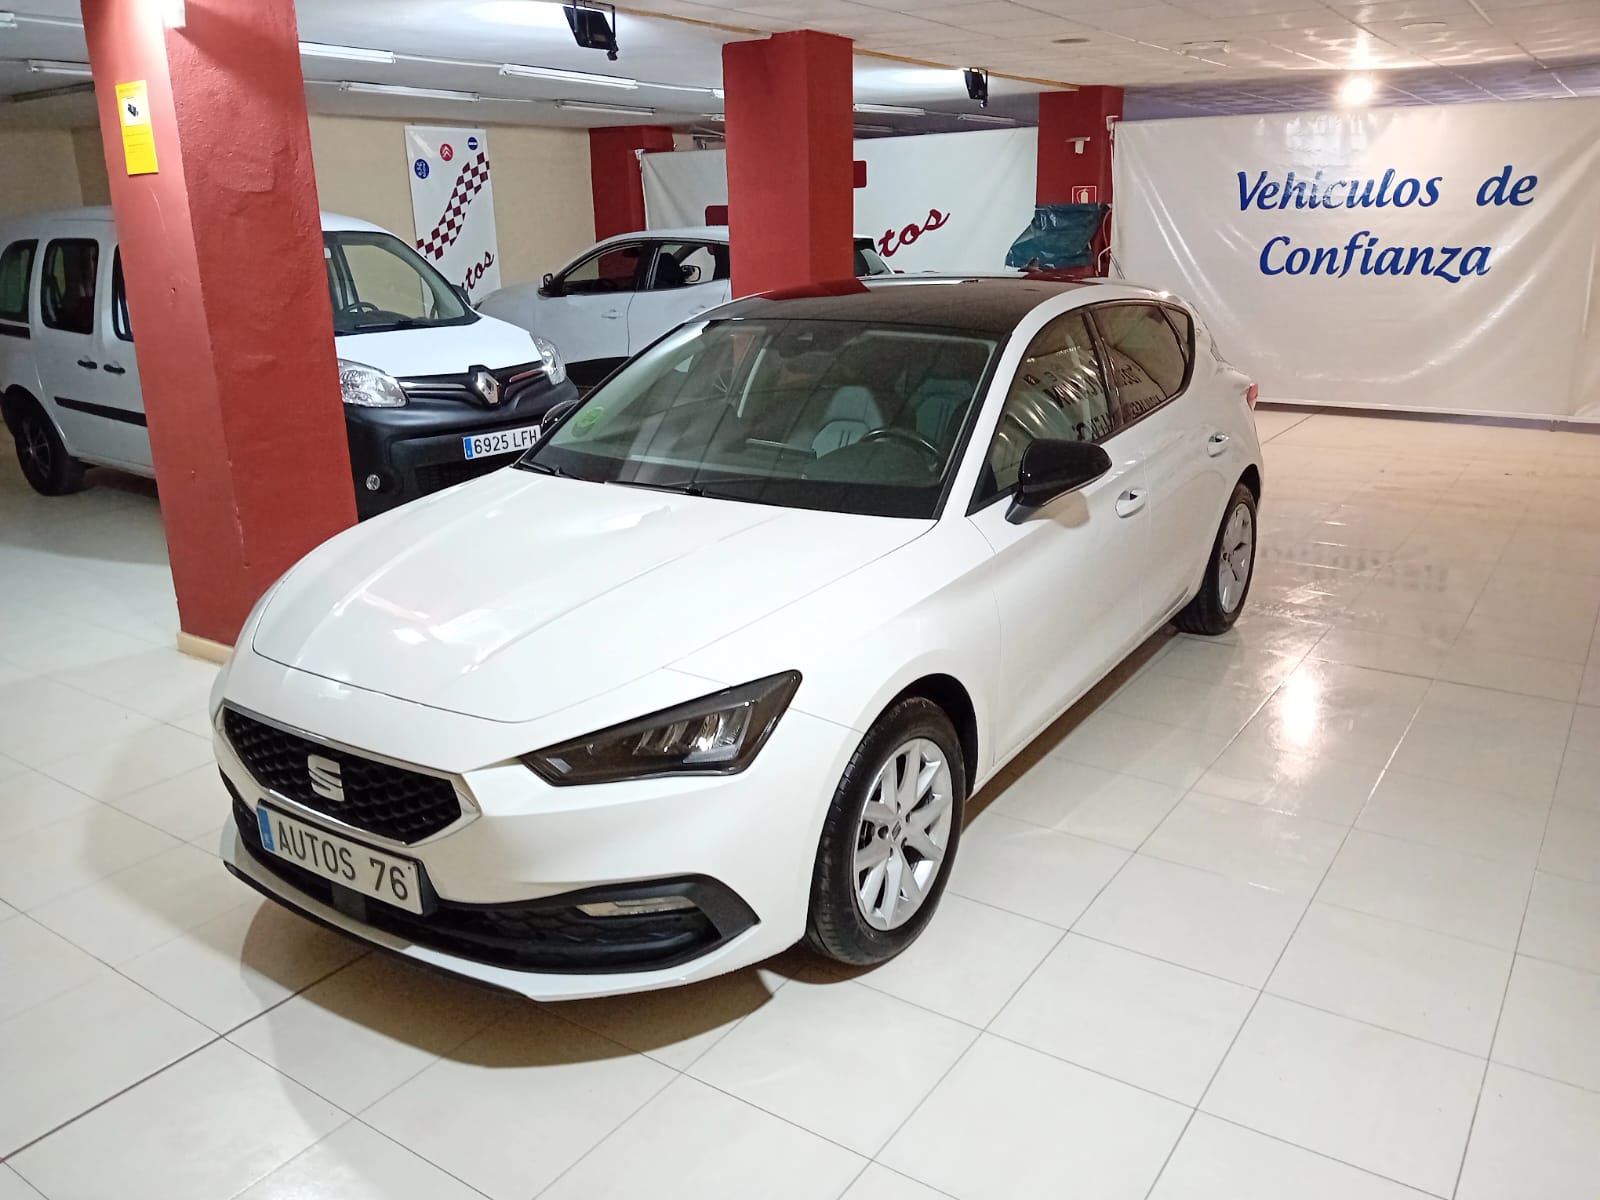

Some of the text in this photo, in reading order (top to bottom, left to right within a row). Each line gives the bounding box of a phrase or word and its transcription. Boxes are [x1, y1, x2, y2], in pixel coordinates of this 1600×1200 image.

[1237, 165, 1538, 211] Vehiculos de
[877, 208, 951, 257] tos
[462, 251, 494, 292] tos
[1260, 231, 1492, 284] Confianza
[474, 429, 537, 454] 6925 LFH
[278, 821, 409, 901] AUTOS 76
